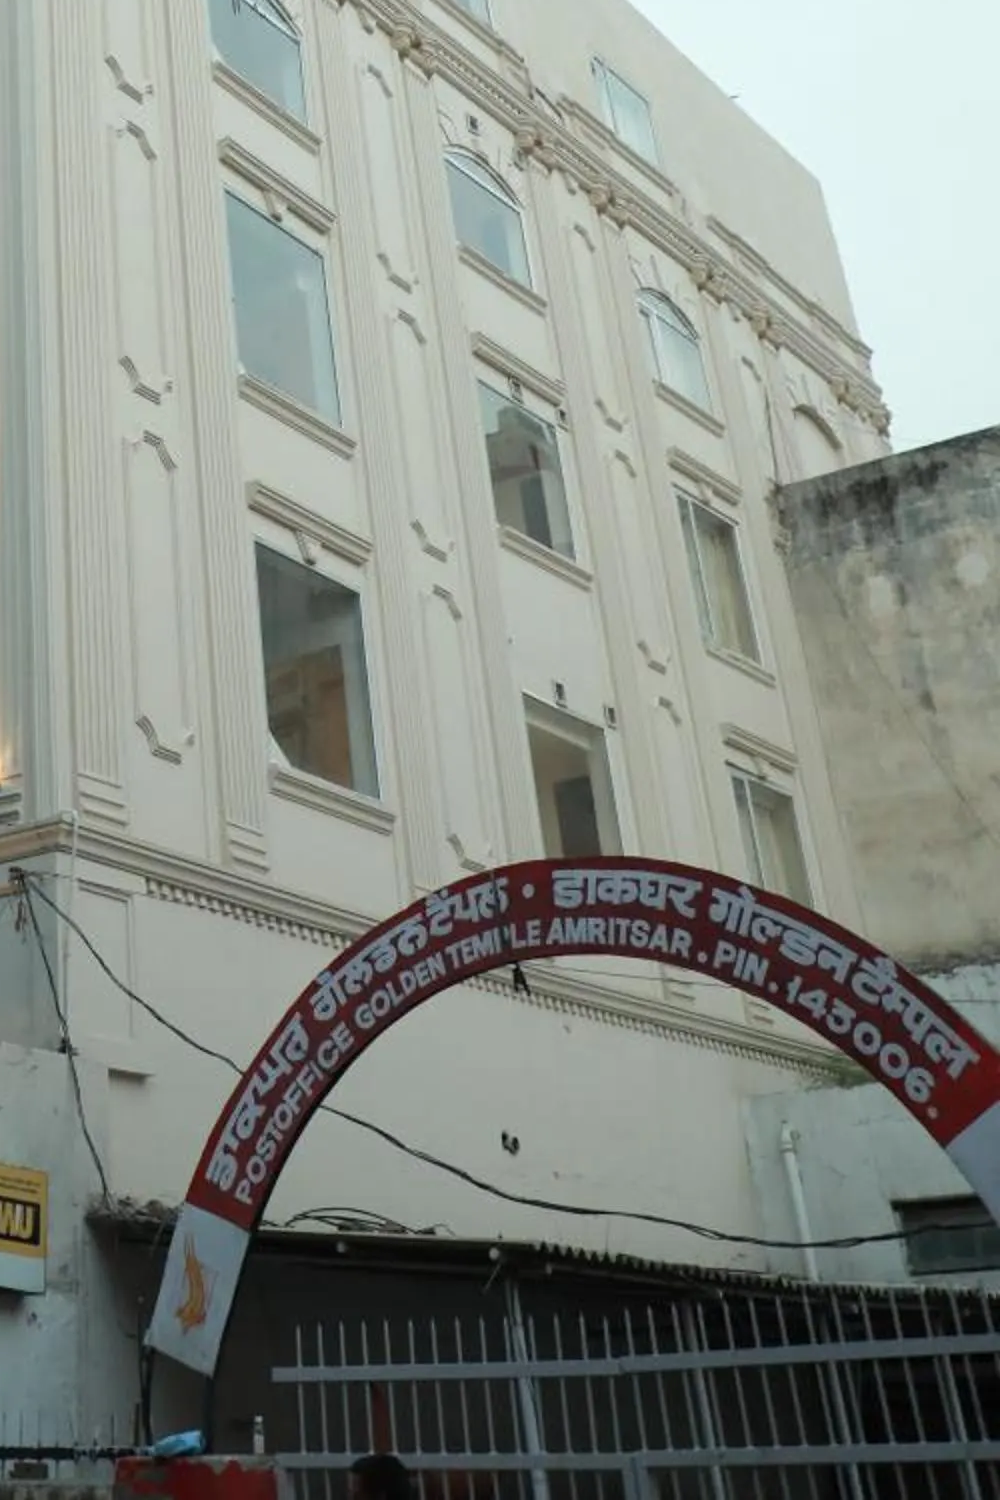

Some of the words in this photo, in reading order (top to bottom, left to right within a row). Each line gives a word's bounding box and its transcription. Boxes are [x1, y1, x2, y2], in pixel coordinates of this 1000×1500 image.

[551, 868, 703, 920] डाकघर
[708, 885, 858, 985] गोल्डन
[354, 951, 447, 1030] GOLDEN
